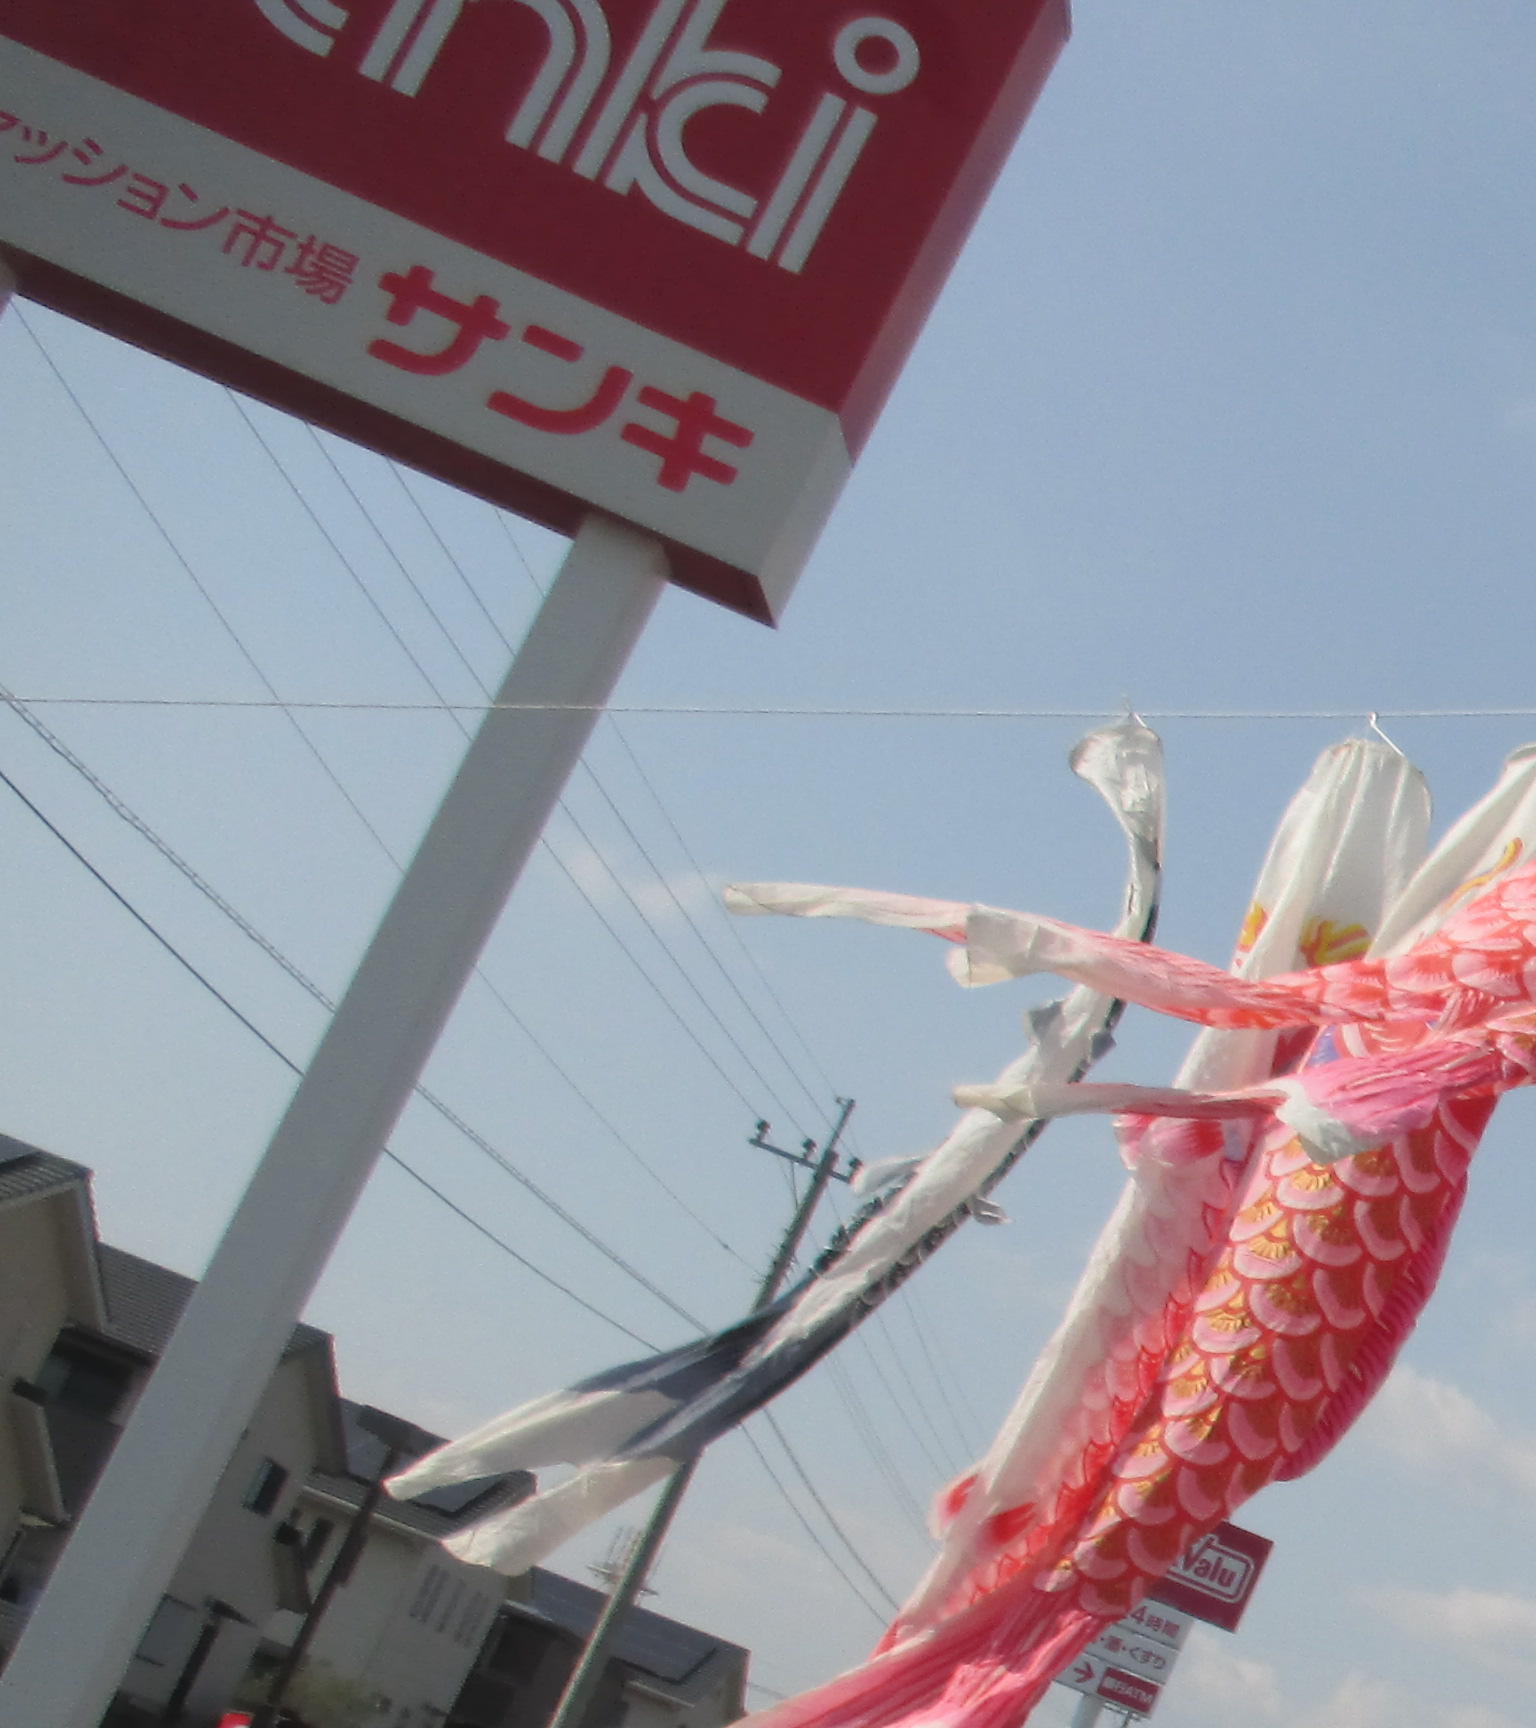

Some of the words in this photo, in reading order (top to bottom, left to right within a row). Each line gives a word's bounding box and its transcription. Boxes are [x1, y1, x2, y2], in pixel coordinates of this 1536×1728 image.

[253, 0, 919, 274] nki
[366, 264, 756, 494] サンキ
